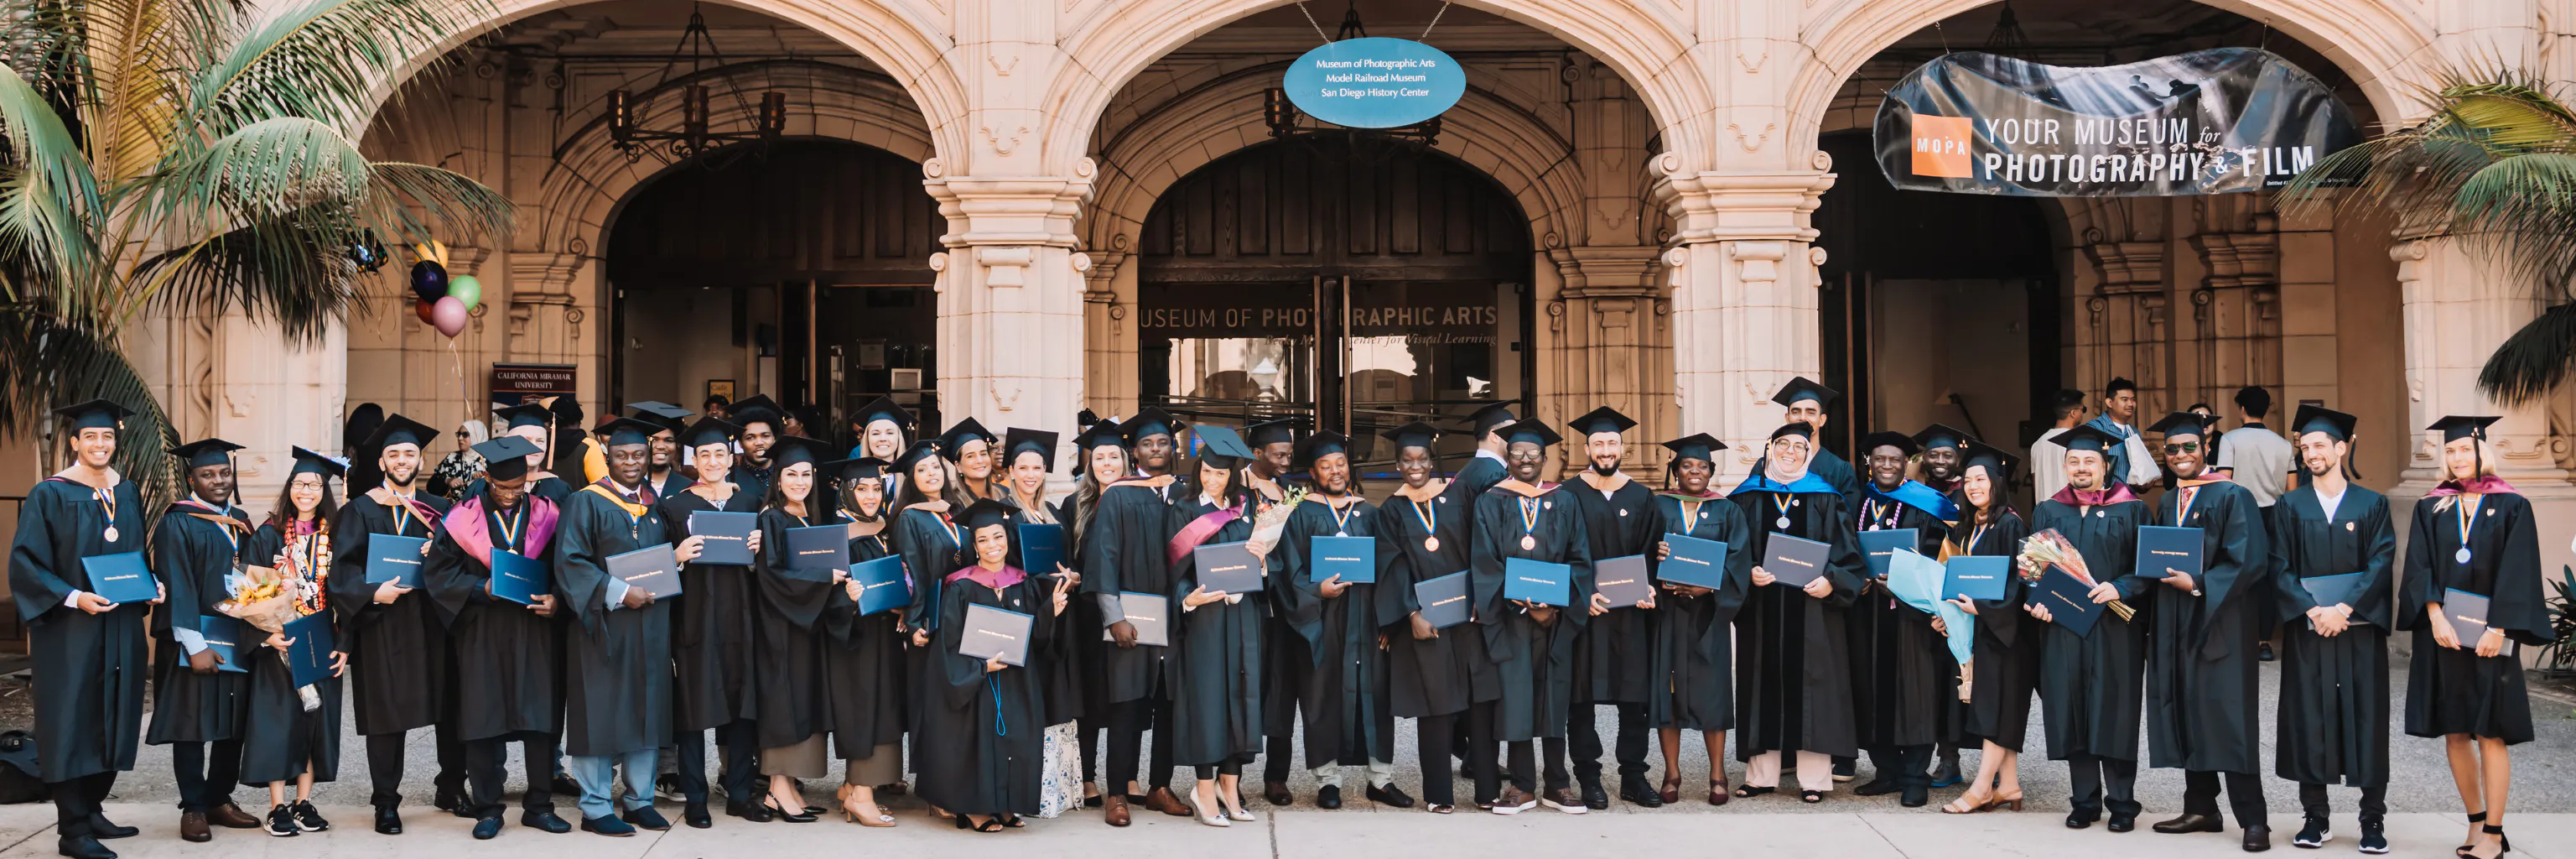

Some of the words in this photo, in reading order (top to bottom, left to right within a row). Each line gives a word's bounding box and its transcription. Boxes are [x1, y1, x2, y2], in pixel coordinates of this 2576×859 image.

[1317, 60, 1352, 68] Museum
[1353, 59, 1363, 68] of
[1363, 59, 1417, 70] Photographic
[1419, 60, 1436, 68] Arts
[1326, 74, 1353, 82] Model
[1355, 73, 1389, 82] Railroad
[1390, 74, 1426, 82] Museum
[1322, 88, 1337, 97] San
[1340, 88, 1365, 99] Diego
[1368, 88, 1398, 99] History
[1400, 88, 1430, 97] Center
[1984, 118, 2059, 145] YOUR
[2075, 117, 2189, 145] MUSEUM
[2199, 127, 2220, 143] for
[1917, 138, 1966, 155] MOPA
[1985, 153, 2204, 182] PHOTOGRAPHY
[2214, 156, 2229, 174] &
[2241, 146, 2314, 176] FILM
[1141, 309, 1215, 327] USEUM
[1226, 309, 1252, 327] OF
[1442, 306, 1497, 325] ARTS
[1384, 334, 1403, 346] for
[1407, 333, 1441, 346] Visual
[1445, 333, 1497, 346] Learning
[497, 372, 538, 380] CALIFORNIA
[539, 372, 571, 381] MIRAMAR
[515, 381, 553, 389] UNIVERSITY
